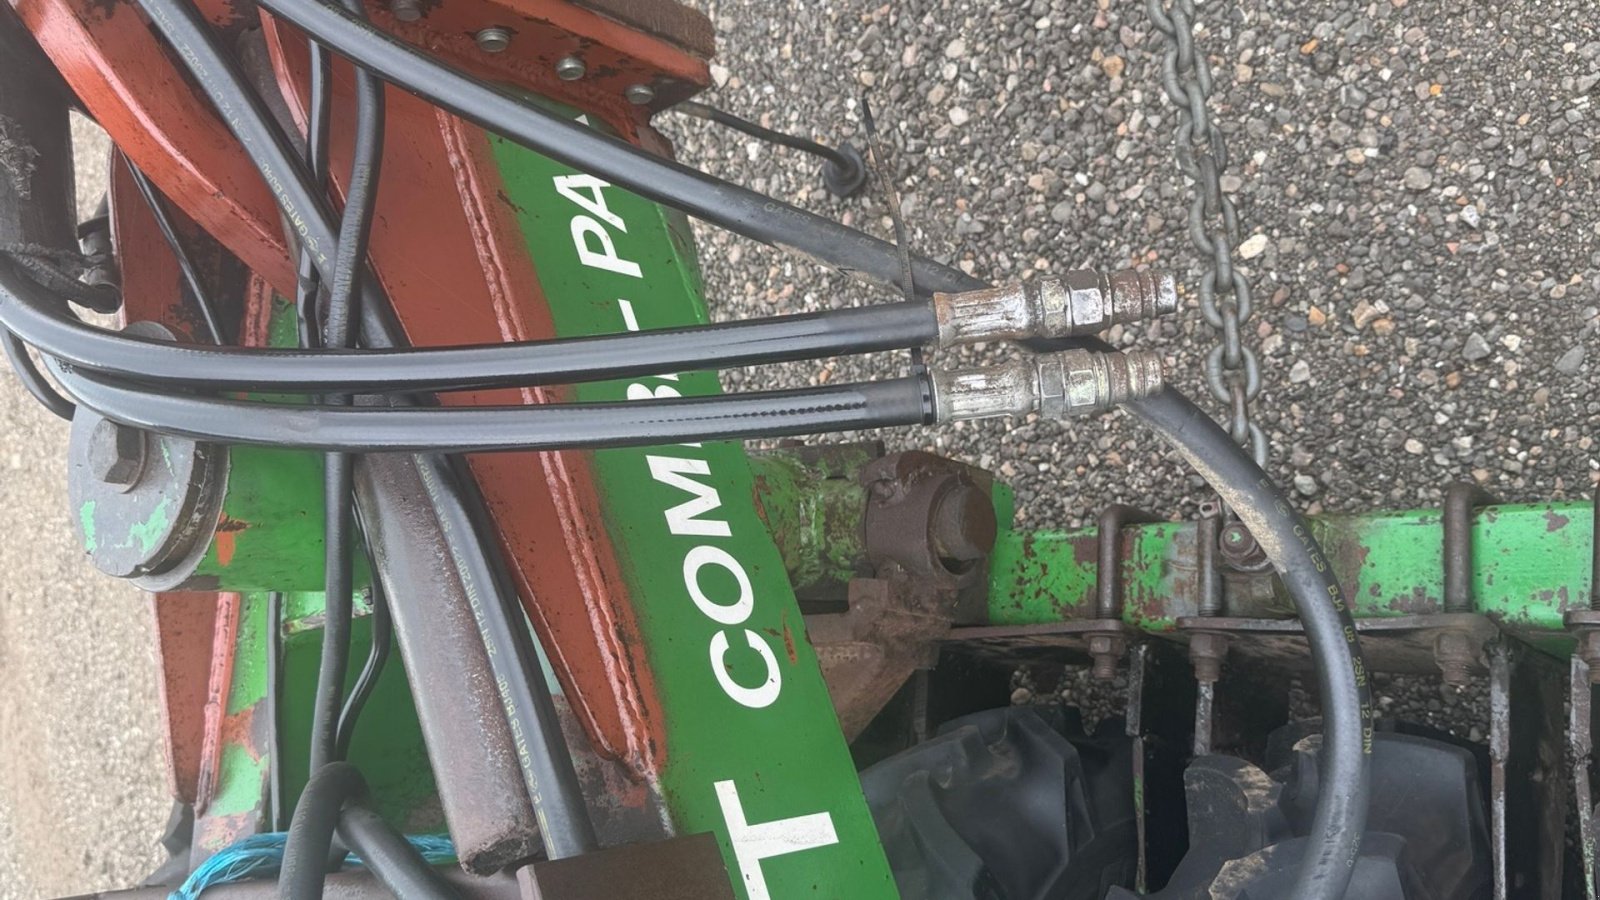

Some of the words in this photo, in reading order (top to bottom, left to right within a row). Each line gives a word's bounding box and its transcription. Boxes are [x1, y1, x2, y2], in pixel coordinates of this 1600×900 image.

[178, 42, 209, 81] 20022
[230, 117, 253, 144] 2N
[279, 192, 310, 237] GATES
[436, 502, 453, 531] SAE
[627, 371, 783, 708] COMB
[1289, 523, 1328, 574] GATES
[451, 544, 472, 582] 20022
[465, 582, 481, 608] DIN
[475, 609, 487, 625] 12
[481, 627, 497, 656] 2SN
[1351, 654, 1367, 687] 2SN
[495, 672, 516, 715] BJ408
[1360, 702, 1370, 719] 12
[509, 717, 532, 768] GATES
[1362, 727, 1372, 754] DIN
